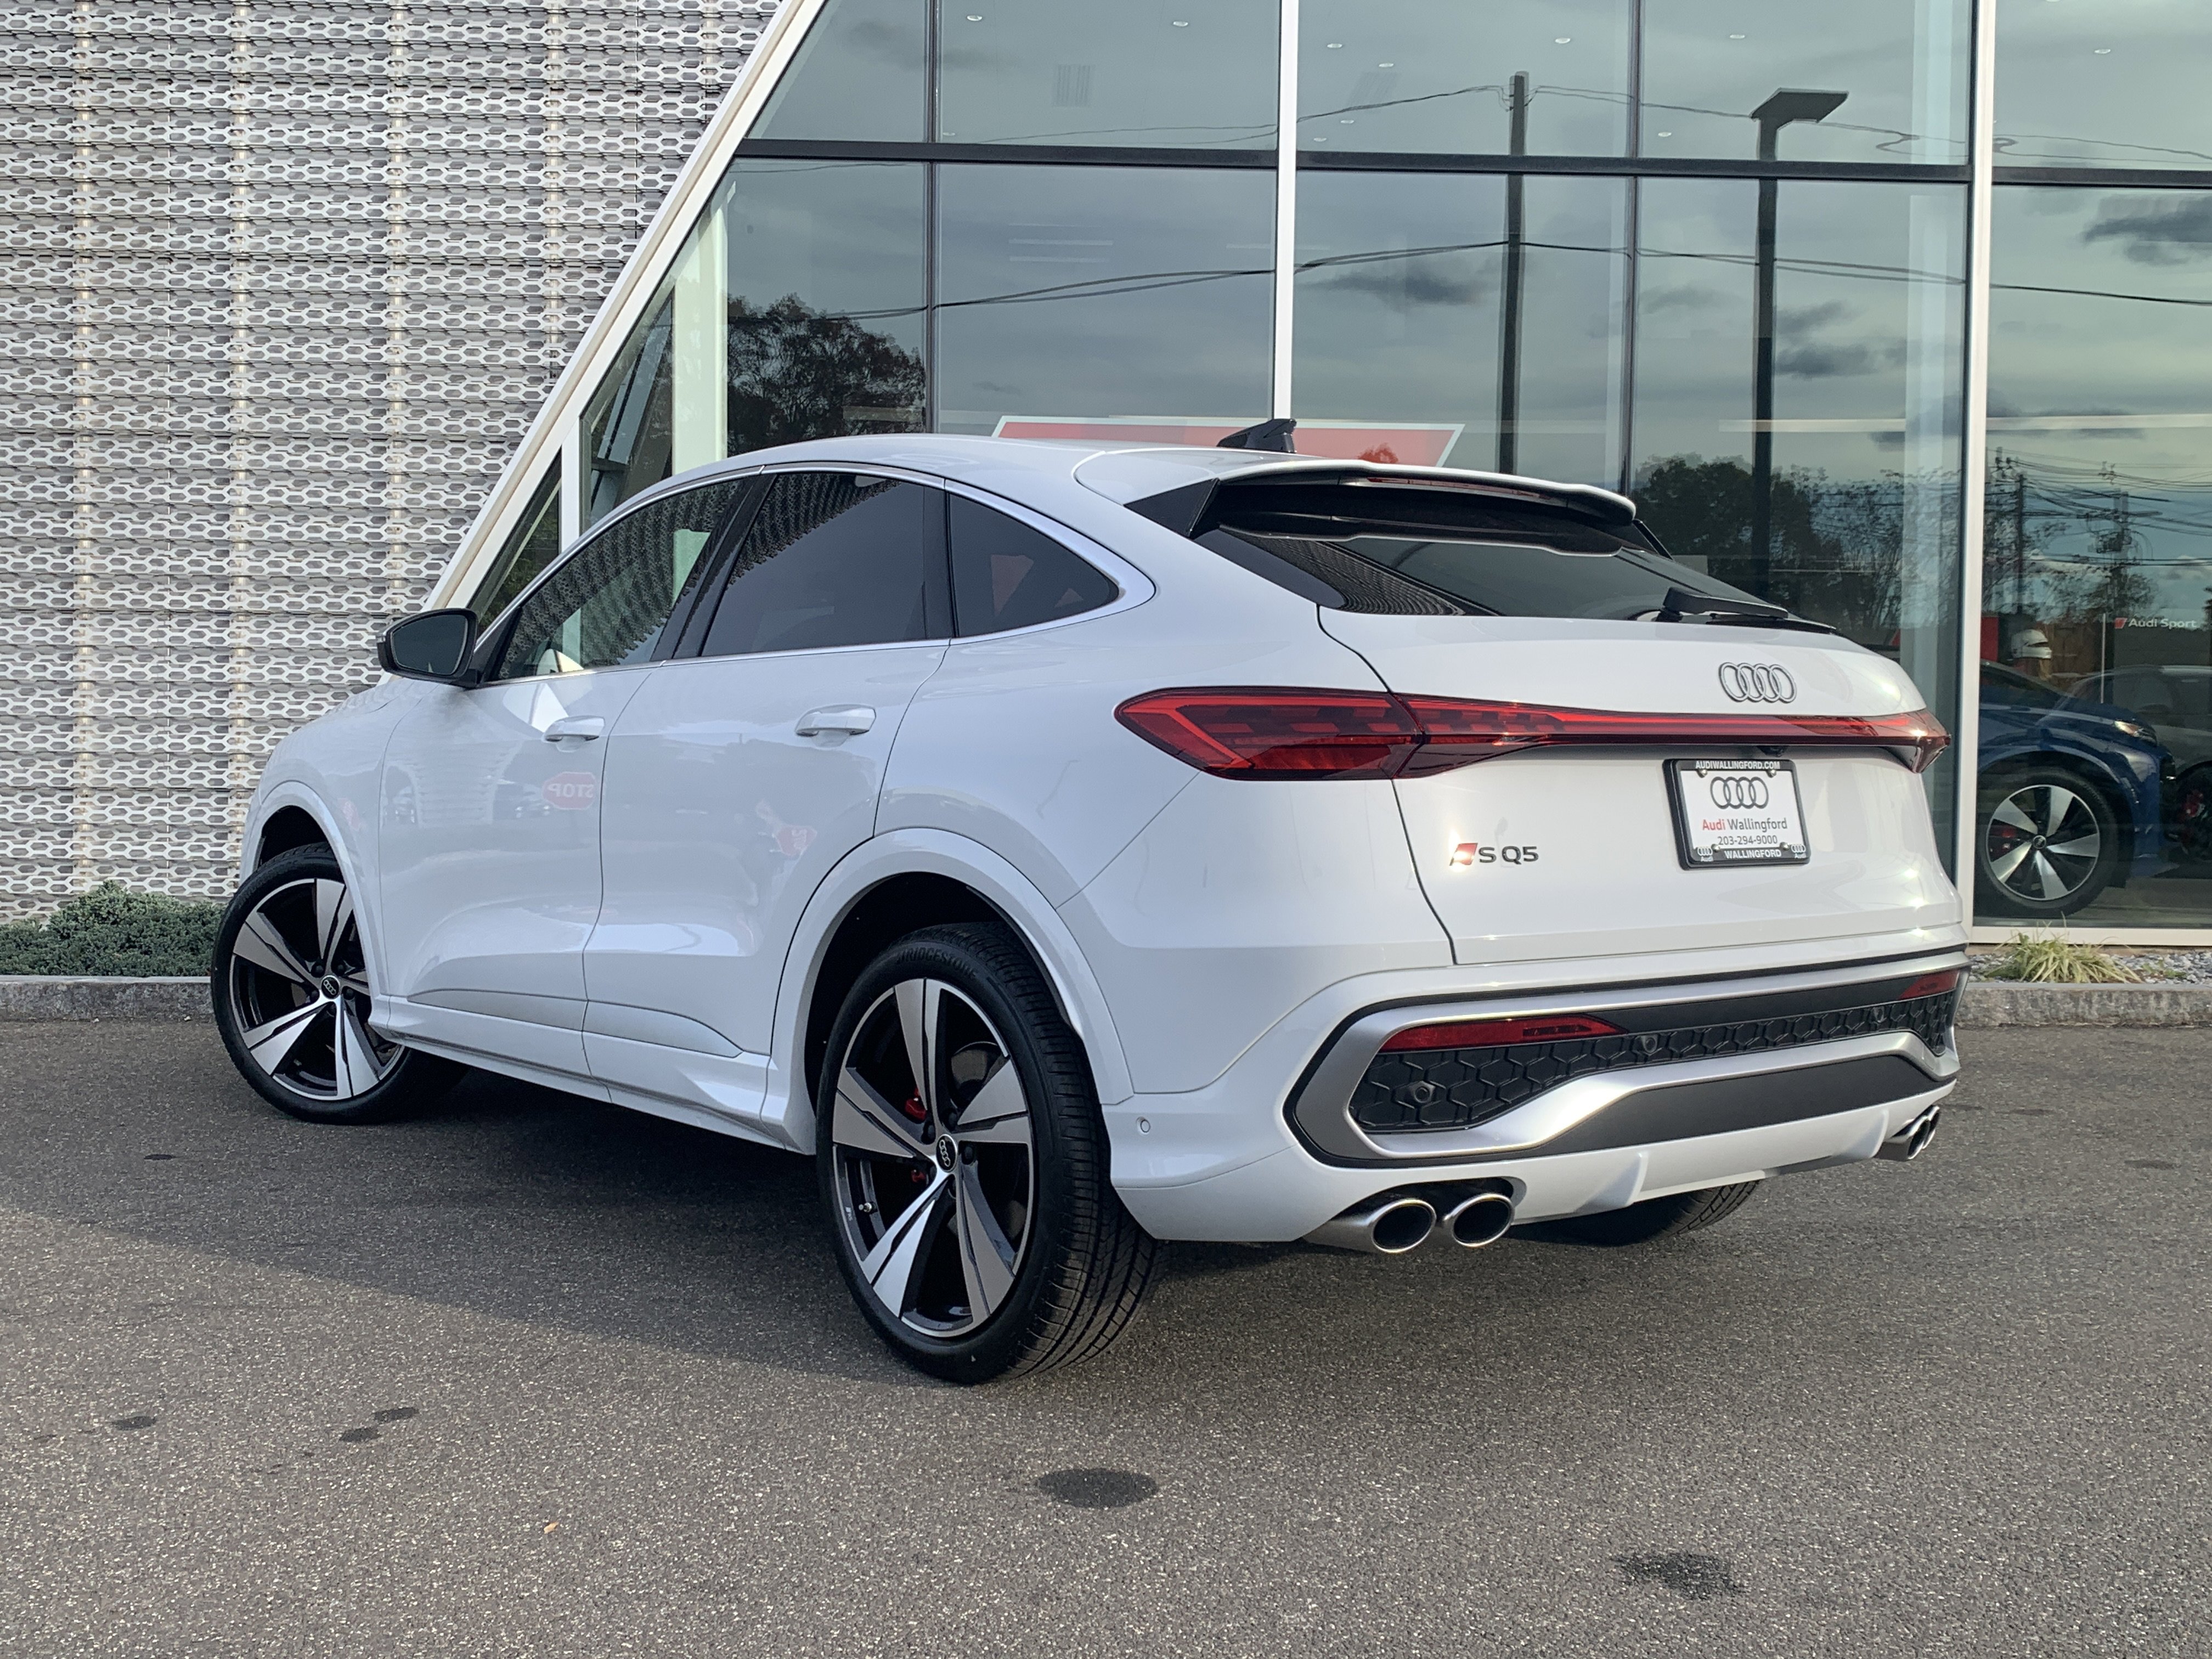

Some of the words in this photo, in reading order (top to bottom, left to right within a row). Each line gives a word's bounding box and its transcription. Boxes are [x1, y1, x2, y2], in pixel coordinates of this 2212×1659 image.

[2128, 618, 2158, 628] Audi
[2159, 618, 2197, 630] Sport
[1695, 760, 1780, 769] AUDIWALLINGFORD.COM
[1702, 819, 1725, 831] Audi
[1727, 817, 1788, 833] Wallingford
[1717, 835, 1778, 845] 203-294-9000
[1724, 849, 1782, 859] WALLINGFORD
